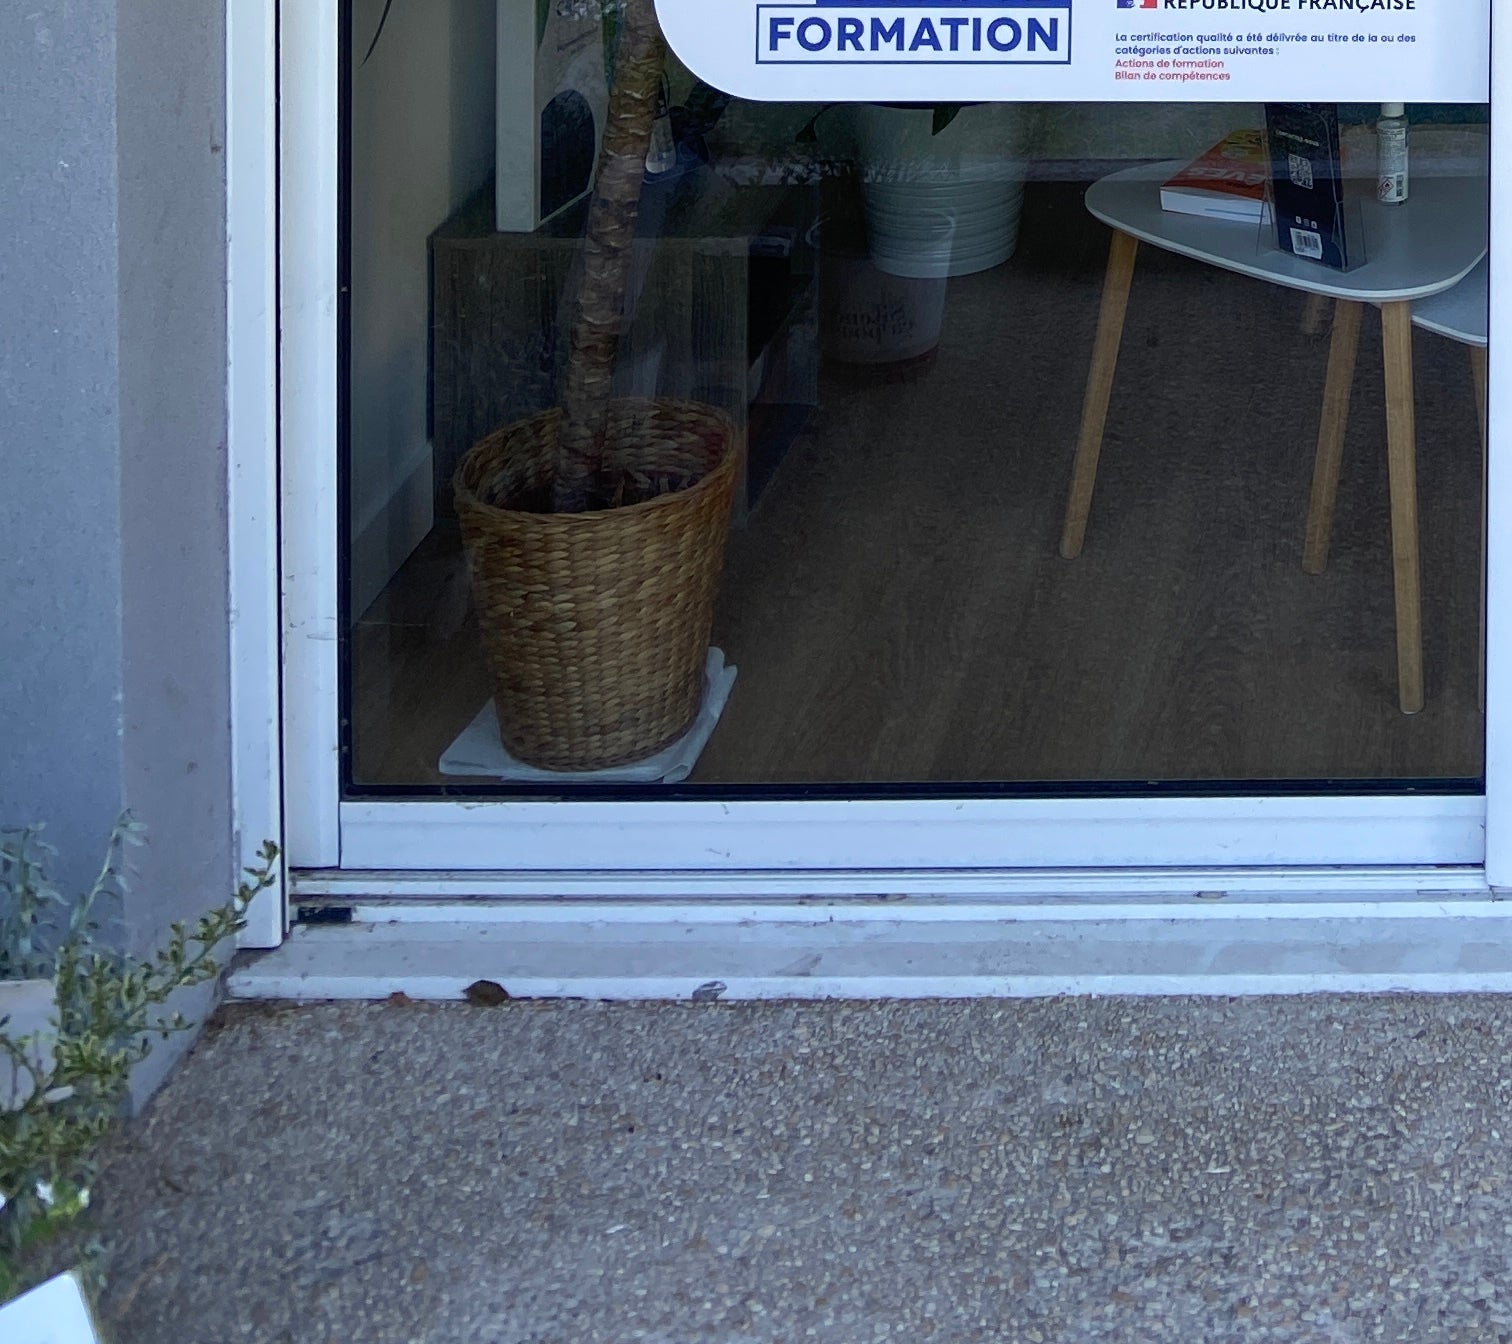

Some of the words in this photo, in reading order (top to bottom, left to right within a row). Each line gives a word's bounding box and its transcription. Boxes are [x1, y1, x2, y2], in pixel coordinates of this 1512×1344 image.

[768, 15, 1060, 53] FORMATION
[1115, 32, 1128, 43] La
[1130, 32, 1194, 43] certification
[1196, 32, 1233, 45] qualité
[1235, 34, 1243, 43] a
[1246, 32, 1263, 43] été
[1265, 32, 1308, 43] délivrée
[1310, 34, 1325, 43] au
[1327, 32, 1349, 43] titre
[1351, 32, 1366, 43] de
[1368, 32, 1378, 43] la
[1380, 34, 1394, 43] ou
[1396, 32, 1416, 43] des
[1114, 45, 1171, 57] catégories
[1223, 46, 1275, 55] suivantes
[1115, 58, 1155, 69] Actions
[1156, 58, 1171, 69] de
[1172, 58, 1225, 69] formation
[1114, 70, 1142, 81] Bilan
[1143, 70, 1157, 81] de
[1158, 70, 1231, 83] compétences
